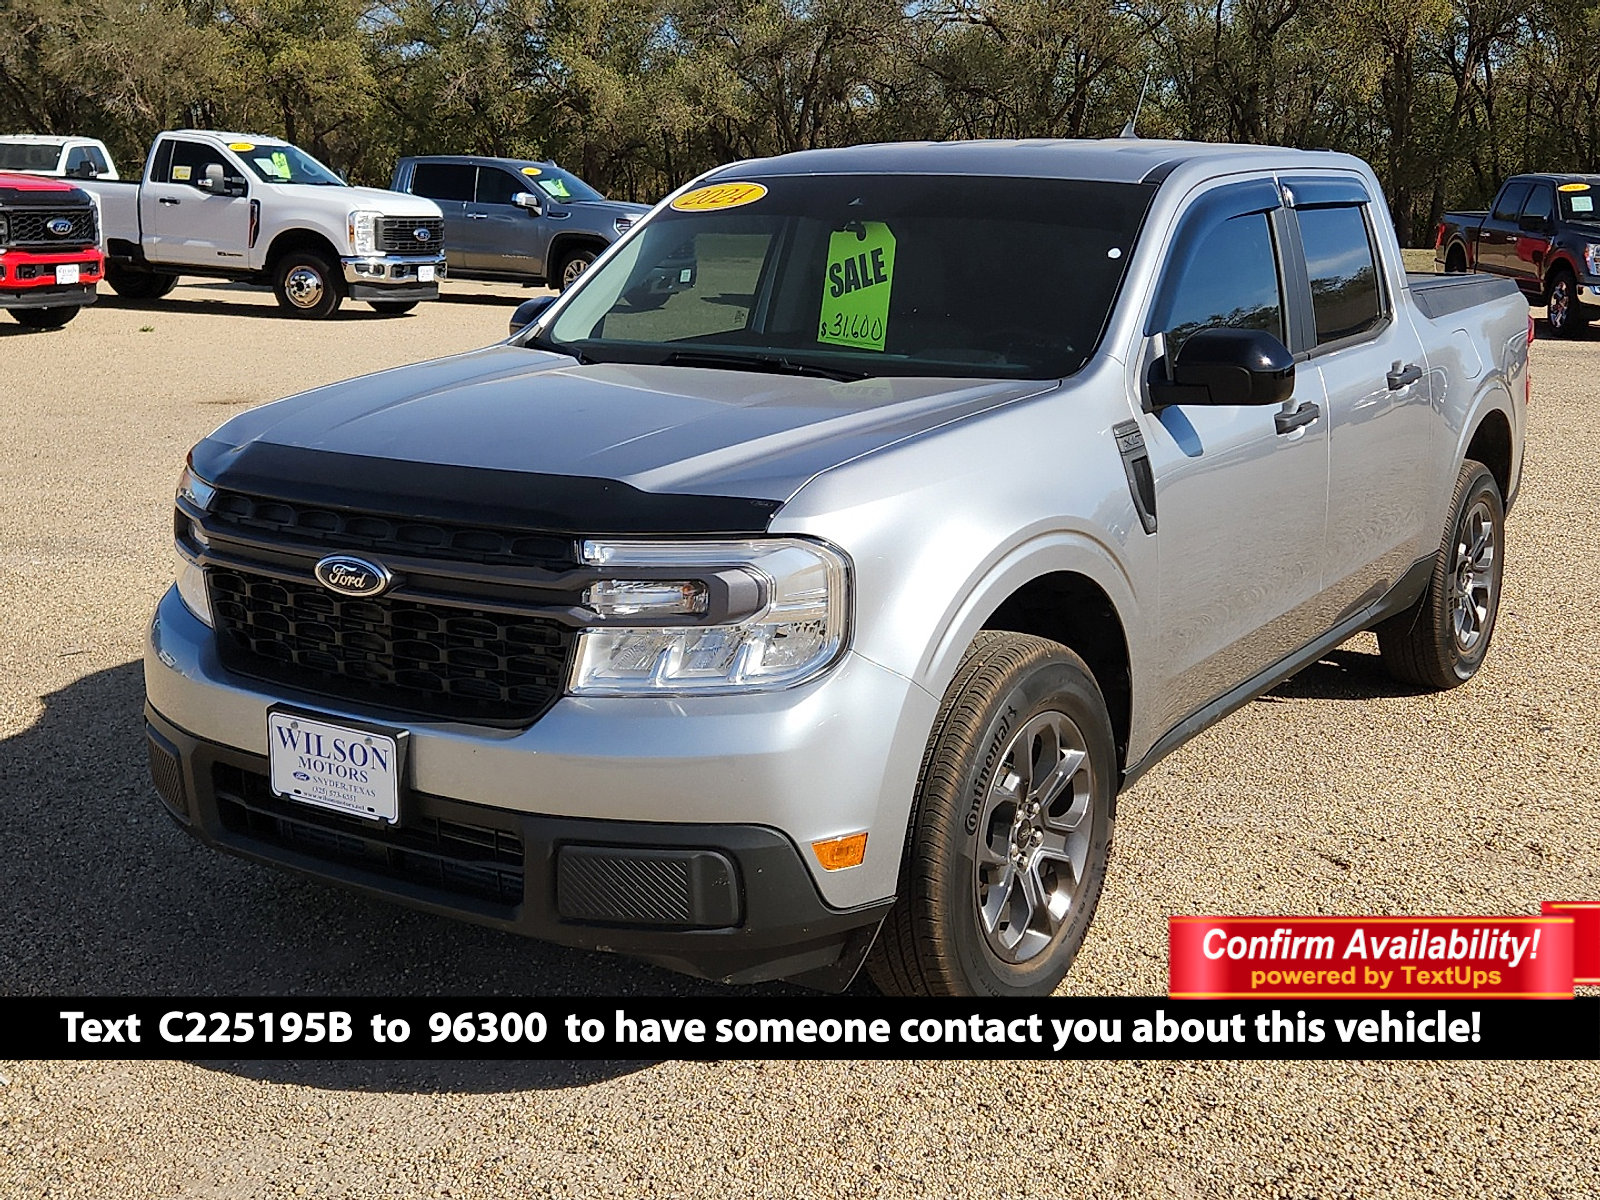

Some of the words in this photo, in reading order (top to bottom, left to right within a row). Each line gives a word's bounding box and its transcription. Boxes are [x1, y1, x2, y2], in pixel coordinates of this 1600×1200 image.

[681, 187, 757, 206] 2024
[828, 247, 888, 298] SALE
[328, 563, 368, 588] Ford
[276, 725, 389, 773] WILSON
[298, 756, 368, 783] MOTORS
[964, 717, 1011, 836] Continental
